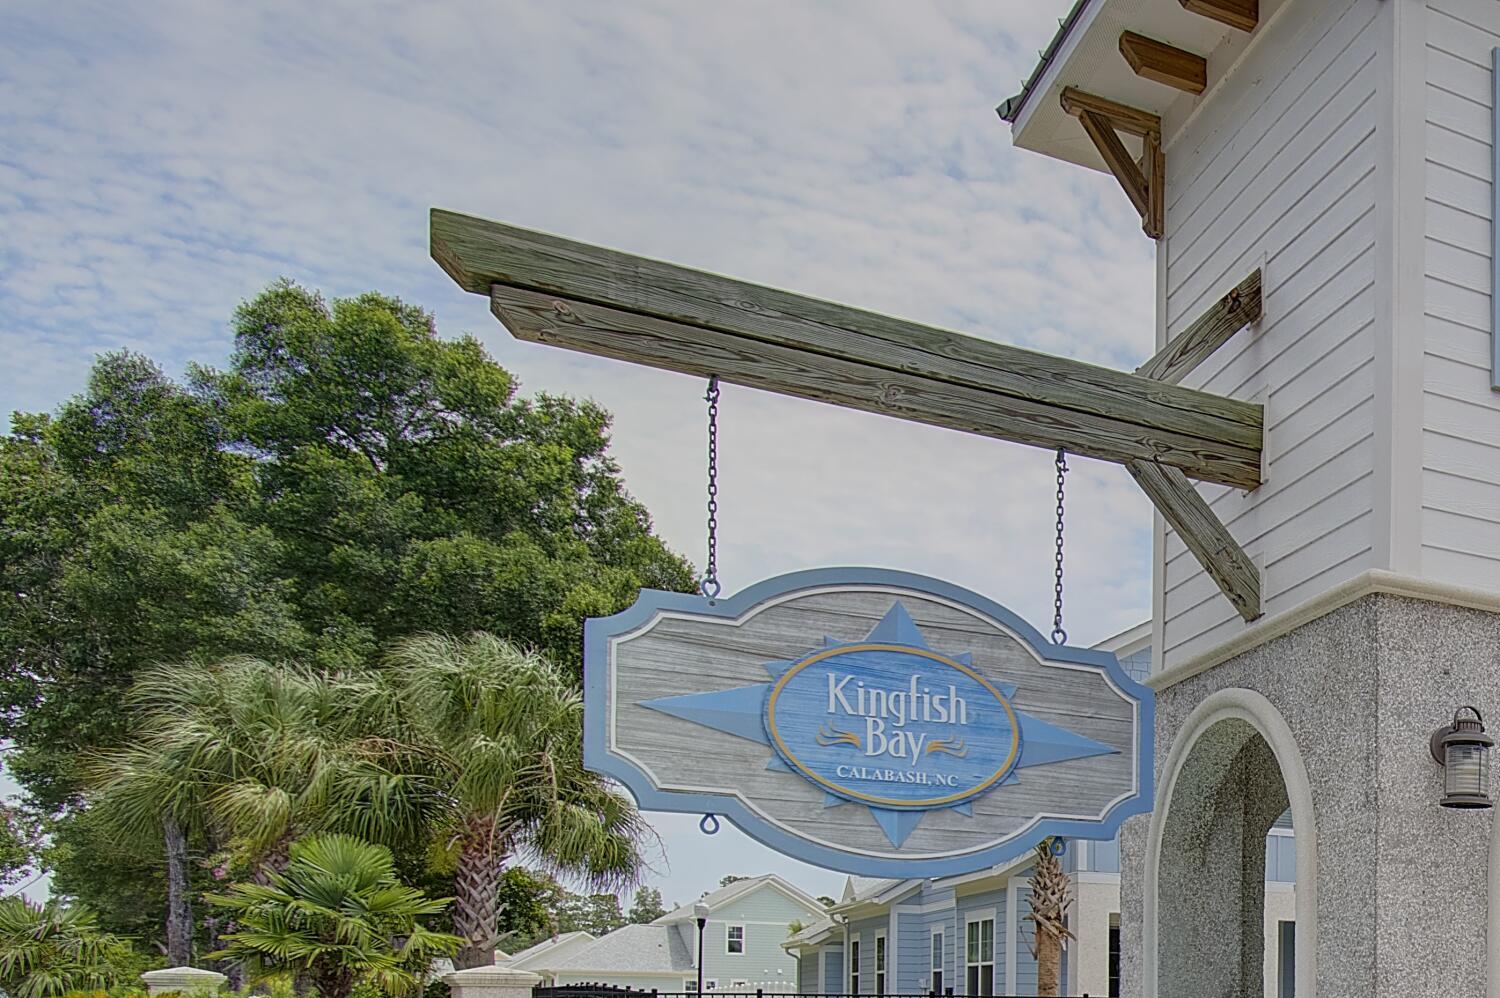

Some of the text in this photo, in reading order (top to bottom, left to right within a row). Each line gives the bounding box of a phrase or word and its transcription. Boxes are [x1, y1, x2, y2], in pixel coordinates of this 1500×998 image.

[827, 672, 968, 727] Kingfish
[864, 717, 927, 766] Bay
[836, 765, 959, 787] CALABASH, NC
